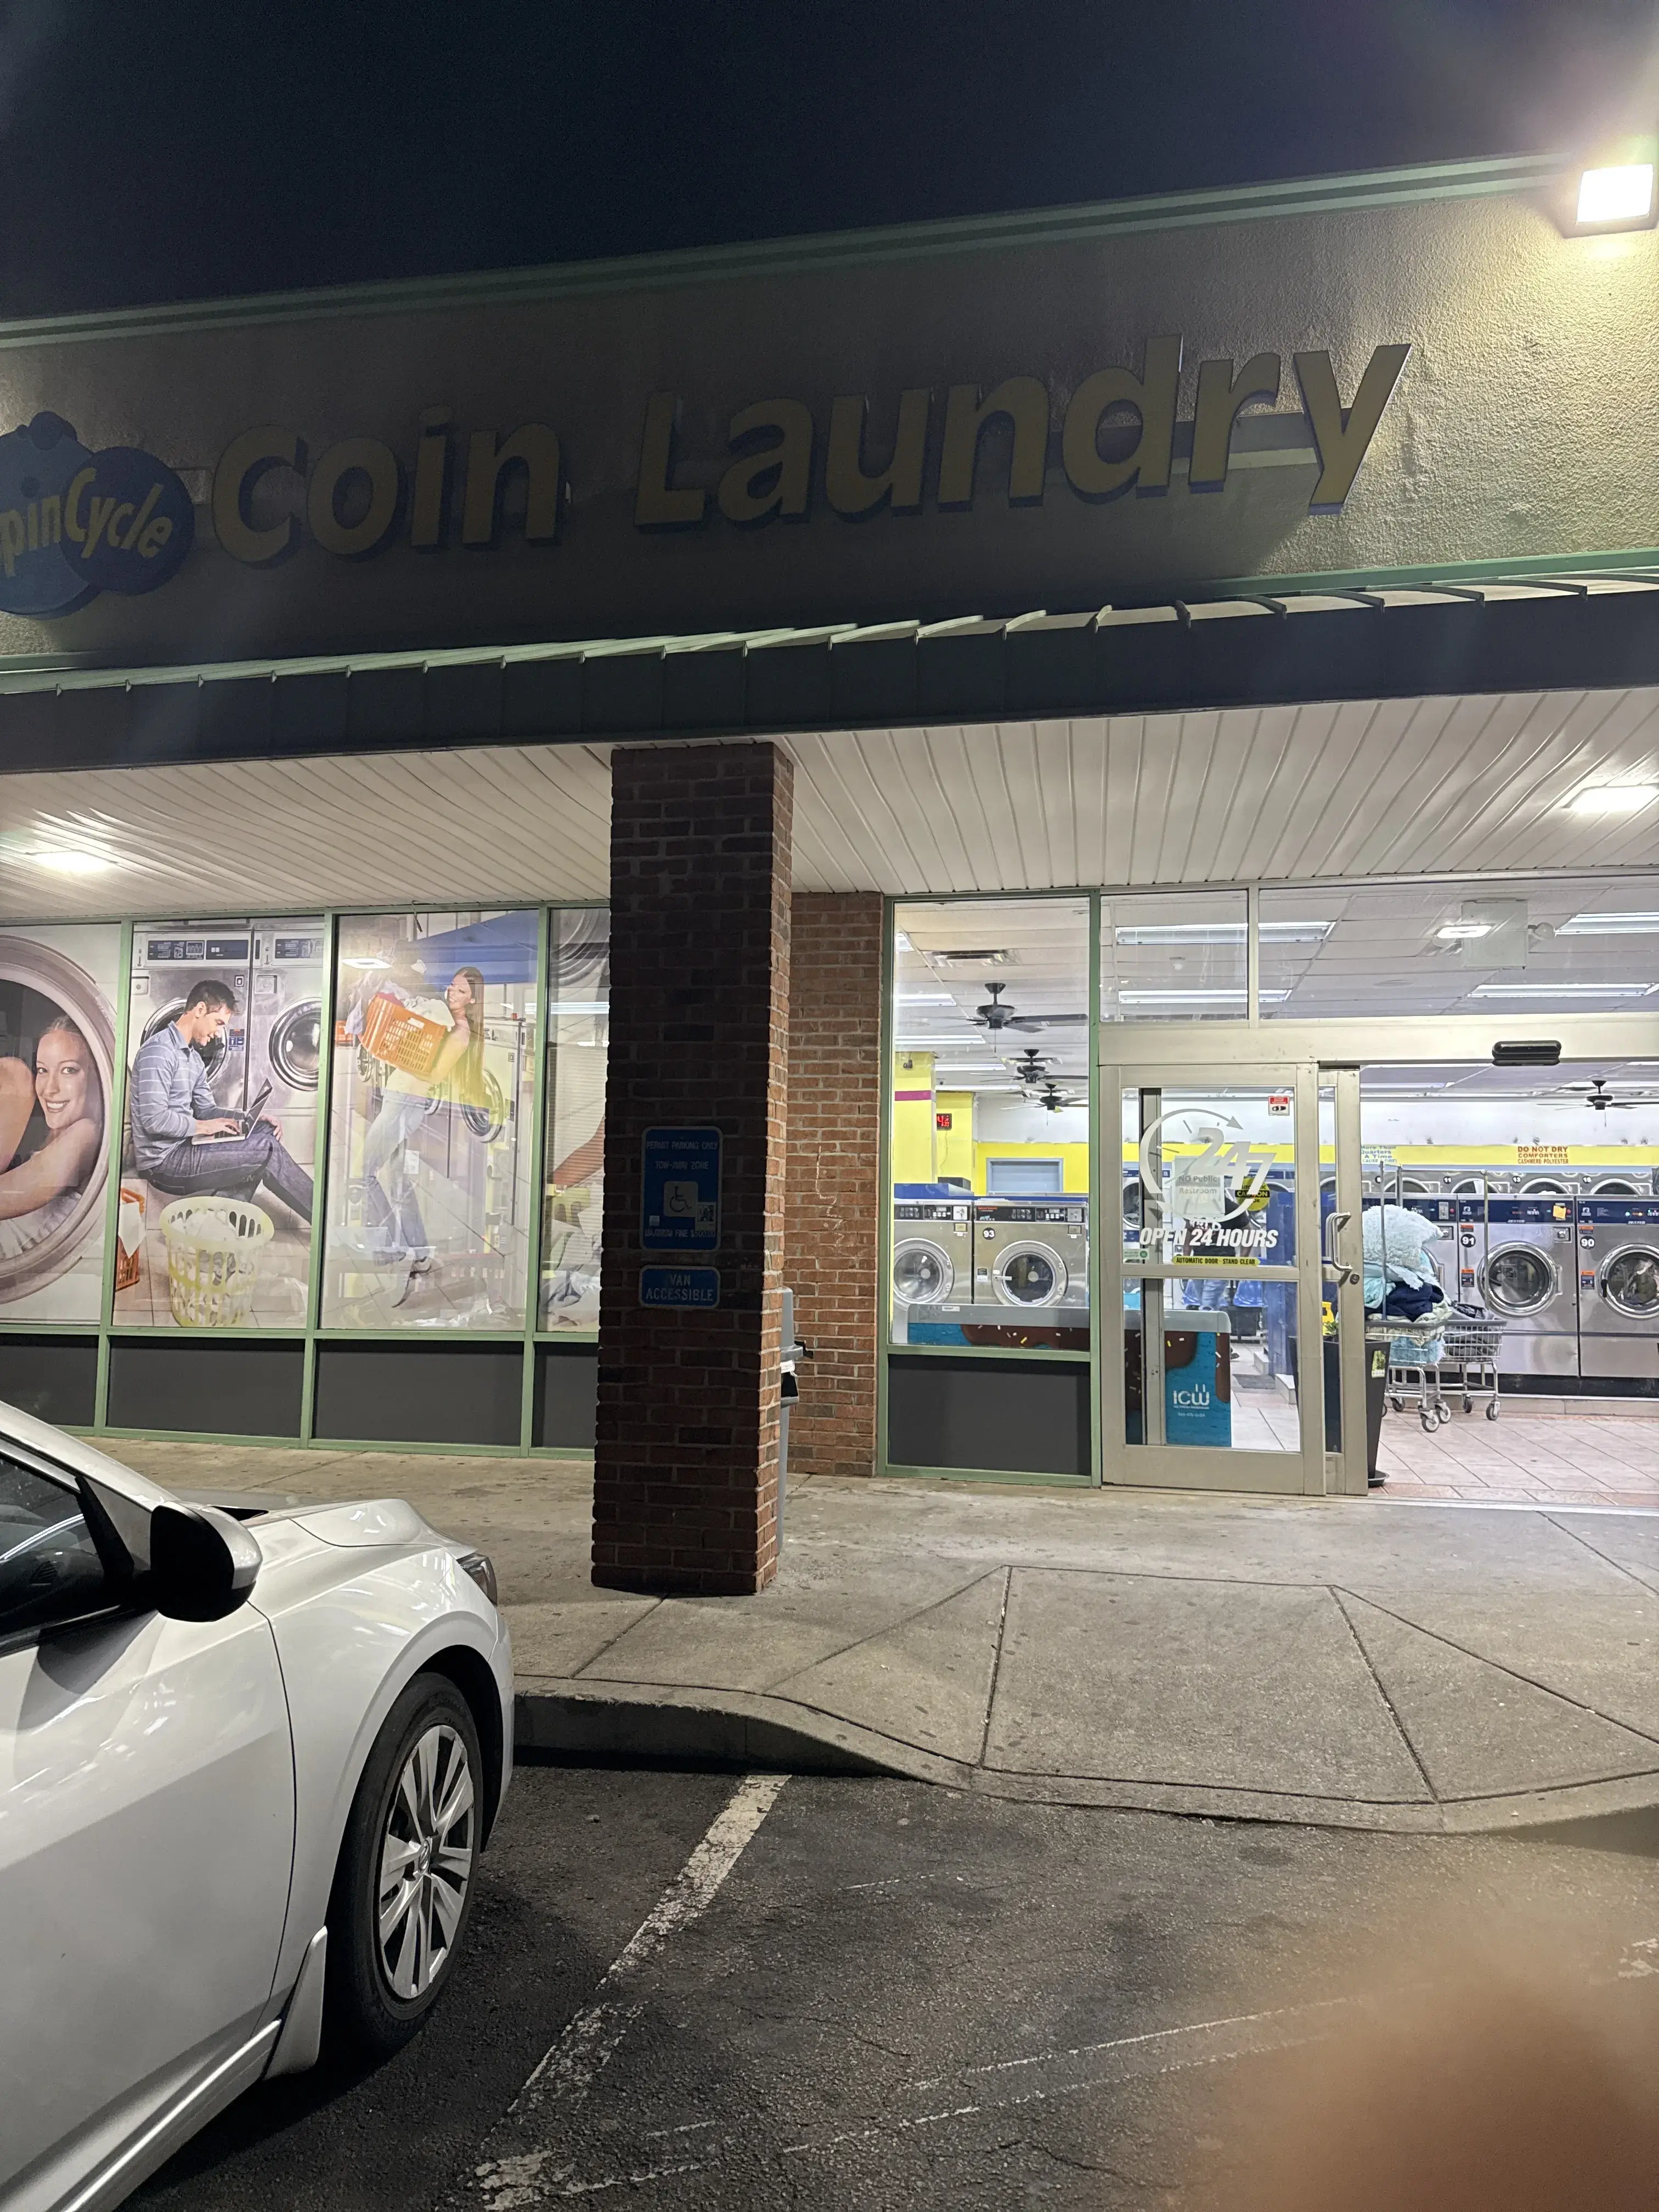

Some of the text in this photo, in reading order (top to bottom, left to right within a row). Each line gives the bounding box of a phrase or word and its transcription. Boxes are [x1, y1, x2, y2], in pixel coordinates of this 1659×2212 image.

[212, 333, 1411, 567] Coin Laundry
[646, 1141, 718, 1150] PERMIT PARKING ONLY
[655, 1161, 709, 1170] TOW-AWAY ZONE
[675, 1229, 689, 1238] FINE
[983, 1229, 995, 1238] 93
[1139, 1227, 1279, 1248] OPEN 24 HOURS
[1462, 1236, 1475, 1245] 91
[1580, 1238, 1595, 1247] 90
[669, 1274, 691, 1286] VAN
[646, 1288, 714, 1301] ACCESSIBLE
